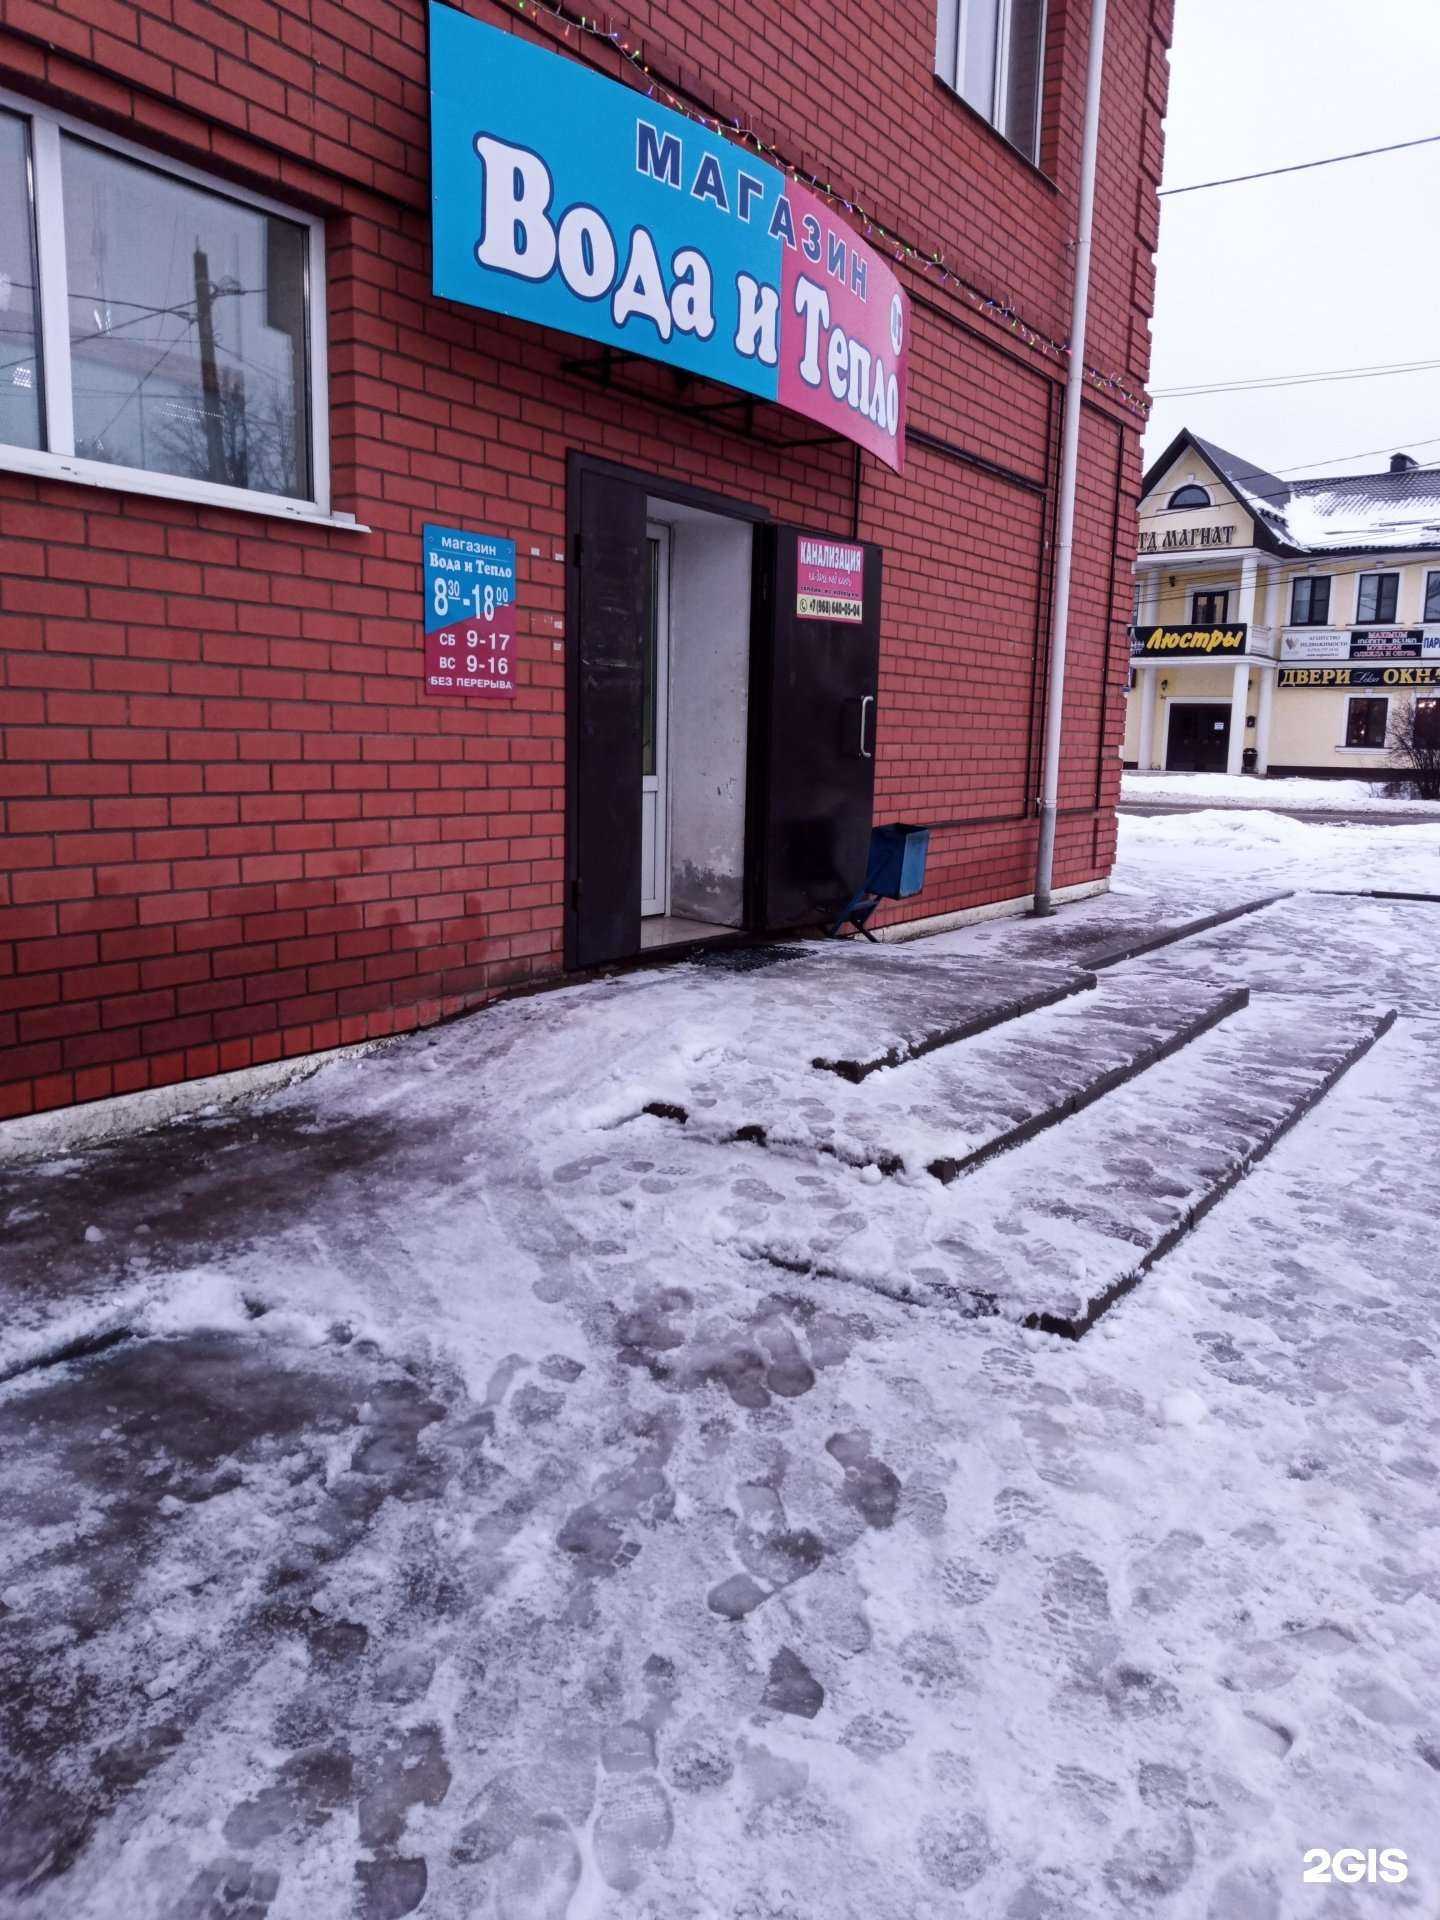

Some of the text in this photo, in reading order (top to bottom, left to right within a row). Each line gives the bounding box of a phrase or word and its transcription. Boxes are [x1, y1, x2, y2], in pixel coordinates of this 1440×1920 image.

[635, 117, 869, 303] МАГАЗИН
[473, 130, 900, 437] Вода и Тепло
[441, 536, 497, 555] магазин
[1162, 525, 1235, 549] МАГНАТ
[429, 552, 512, 578] Вода и Тепло
[800, 541, 861, 574] КАНАЛИЗАЦИЯ
[439, 630, 510, 651] СБ 9-17
[1146, 628, 1244, 652] Люстры
[439, 655, 508, 675] ВС 9-16
[430, 676, 512, 689] БЕЗ ПЕРЕРЫВА
[1280, 669, 1351, 687] ДВЕРИ
